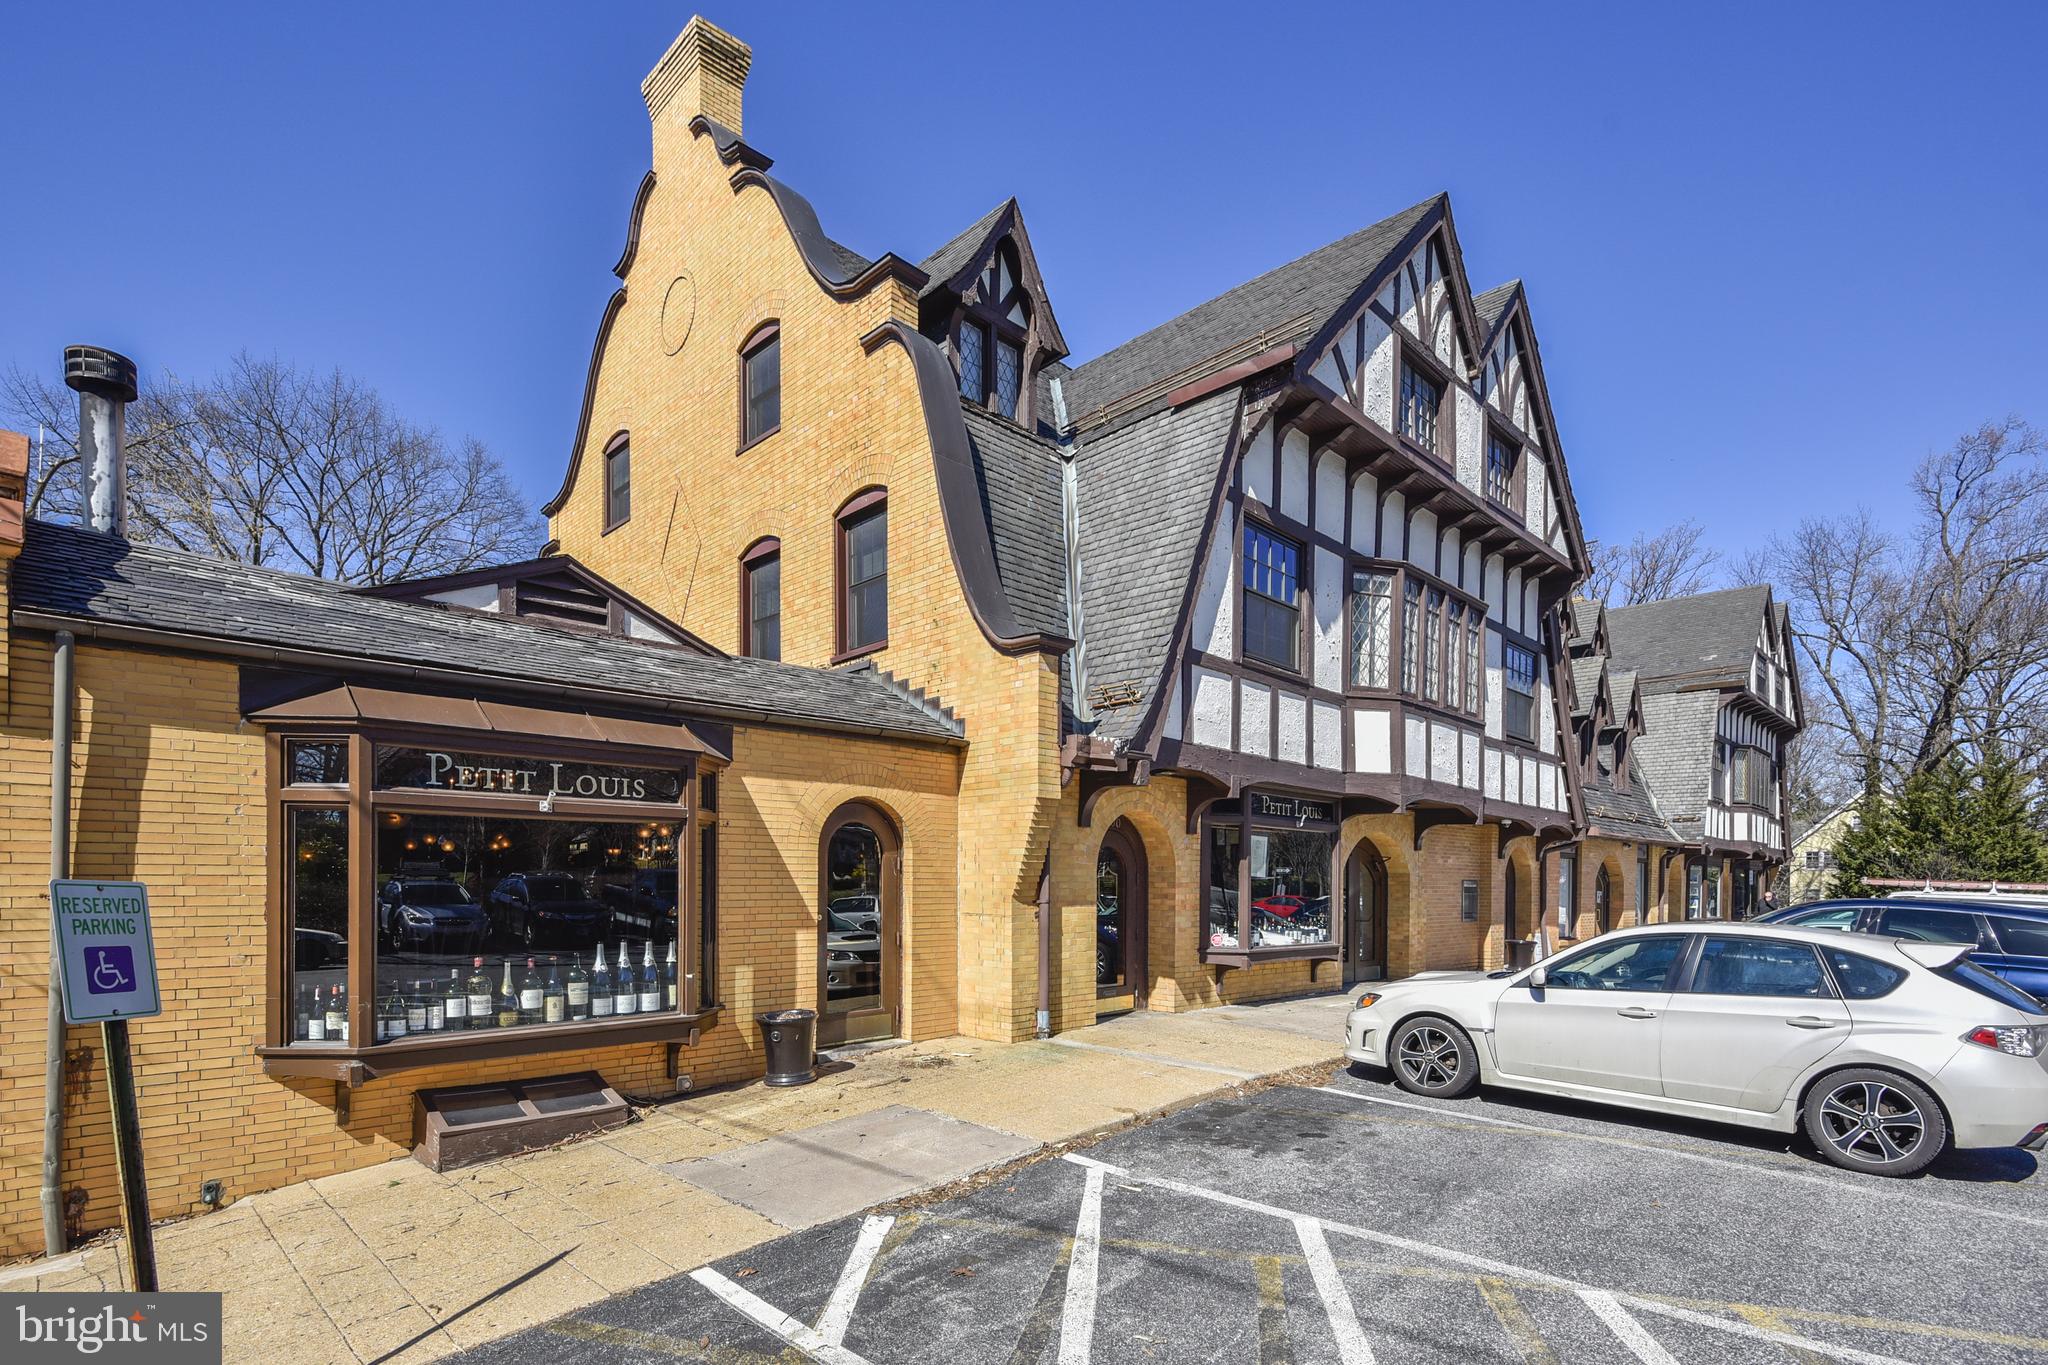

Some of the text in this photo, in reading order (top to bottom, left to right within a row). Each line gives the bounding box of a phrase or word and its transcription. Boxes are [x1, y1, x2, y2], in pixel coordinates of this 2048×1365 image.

[426, 752, 646, 799] PETIT LOUIS
[1262, 795, 1323, 819] PETIT LOUIS
[60, 896, 141, 914] RESERVED
[71, 918, 136, 935] PARKING
